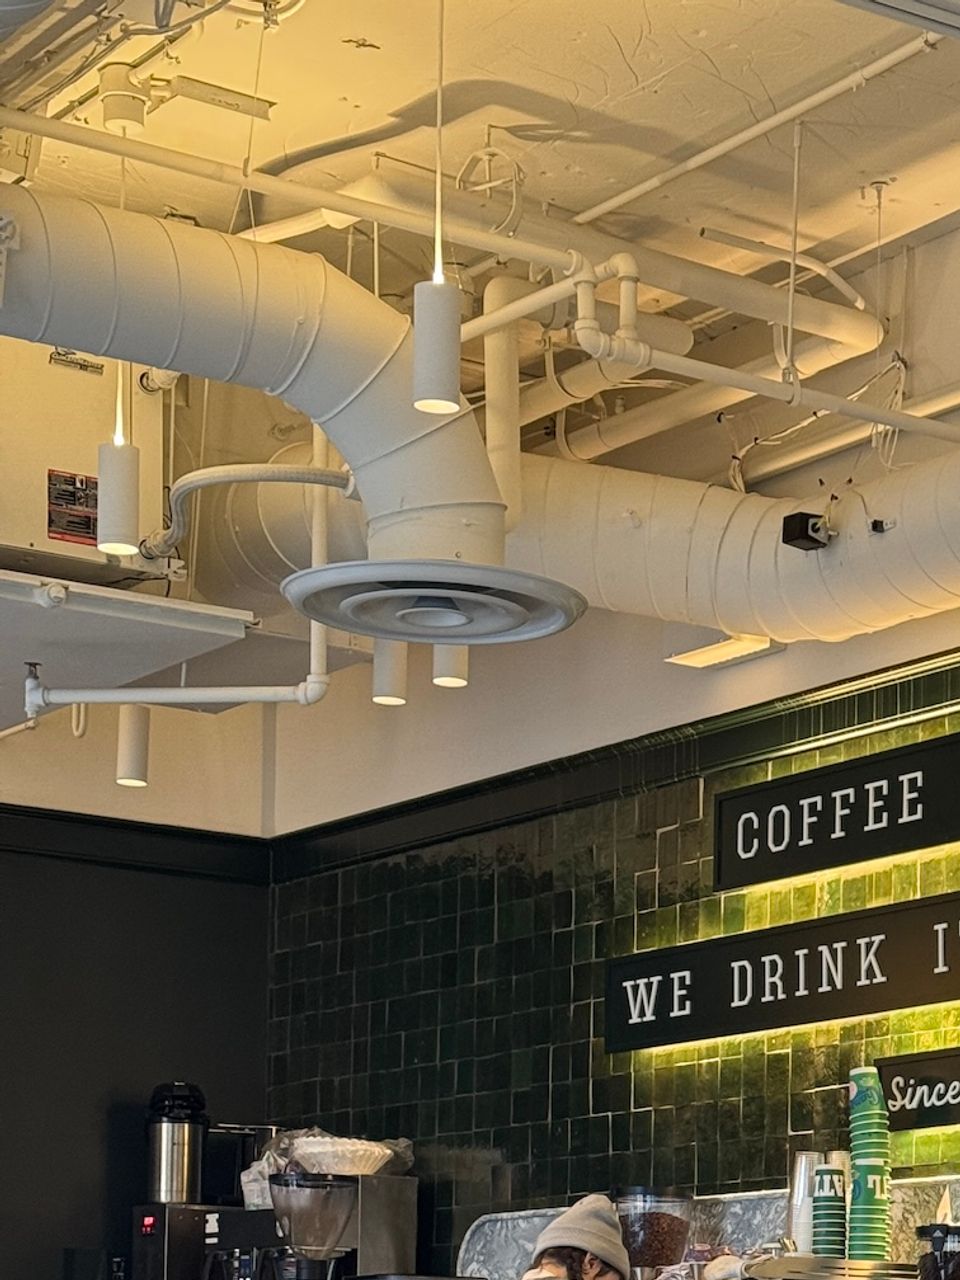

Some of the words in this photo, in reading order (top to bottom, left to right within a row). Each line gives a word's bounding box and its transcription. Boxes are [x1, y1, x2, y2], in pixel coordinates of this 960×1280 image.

[737, 771, 923, 859] COFFEE
[622, 970, 691, 1024] WE
[730, 934, 887, 1008] DRINK
